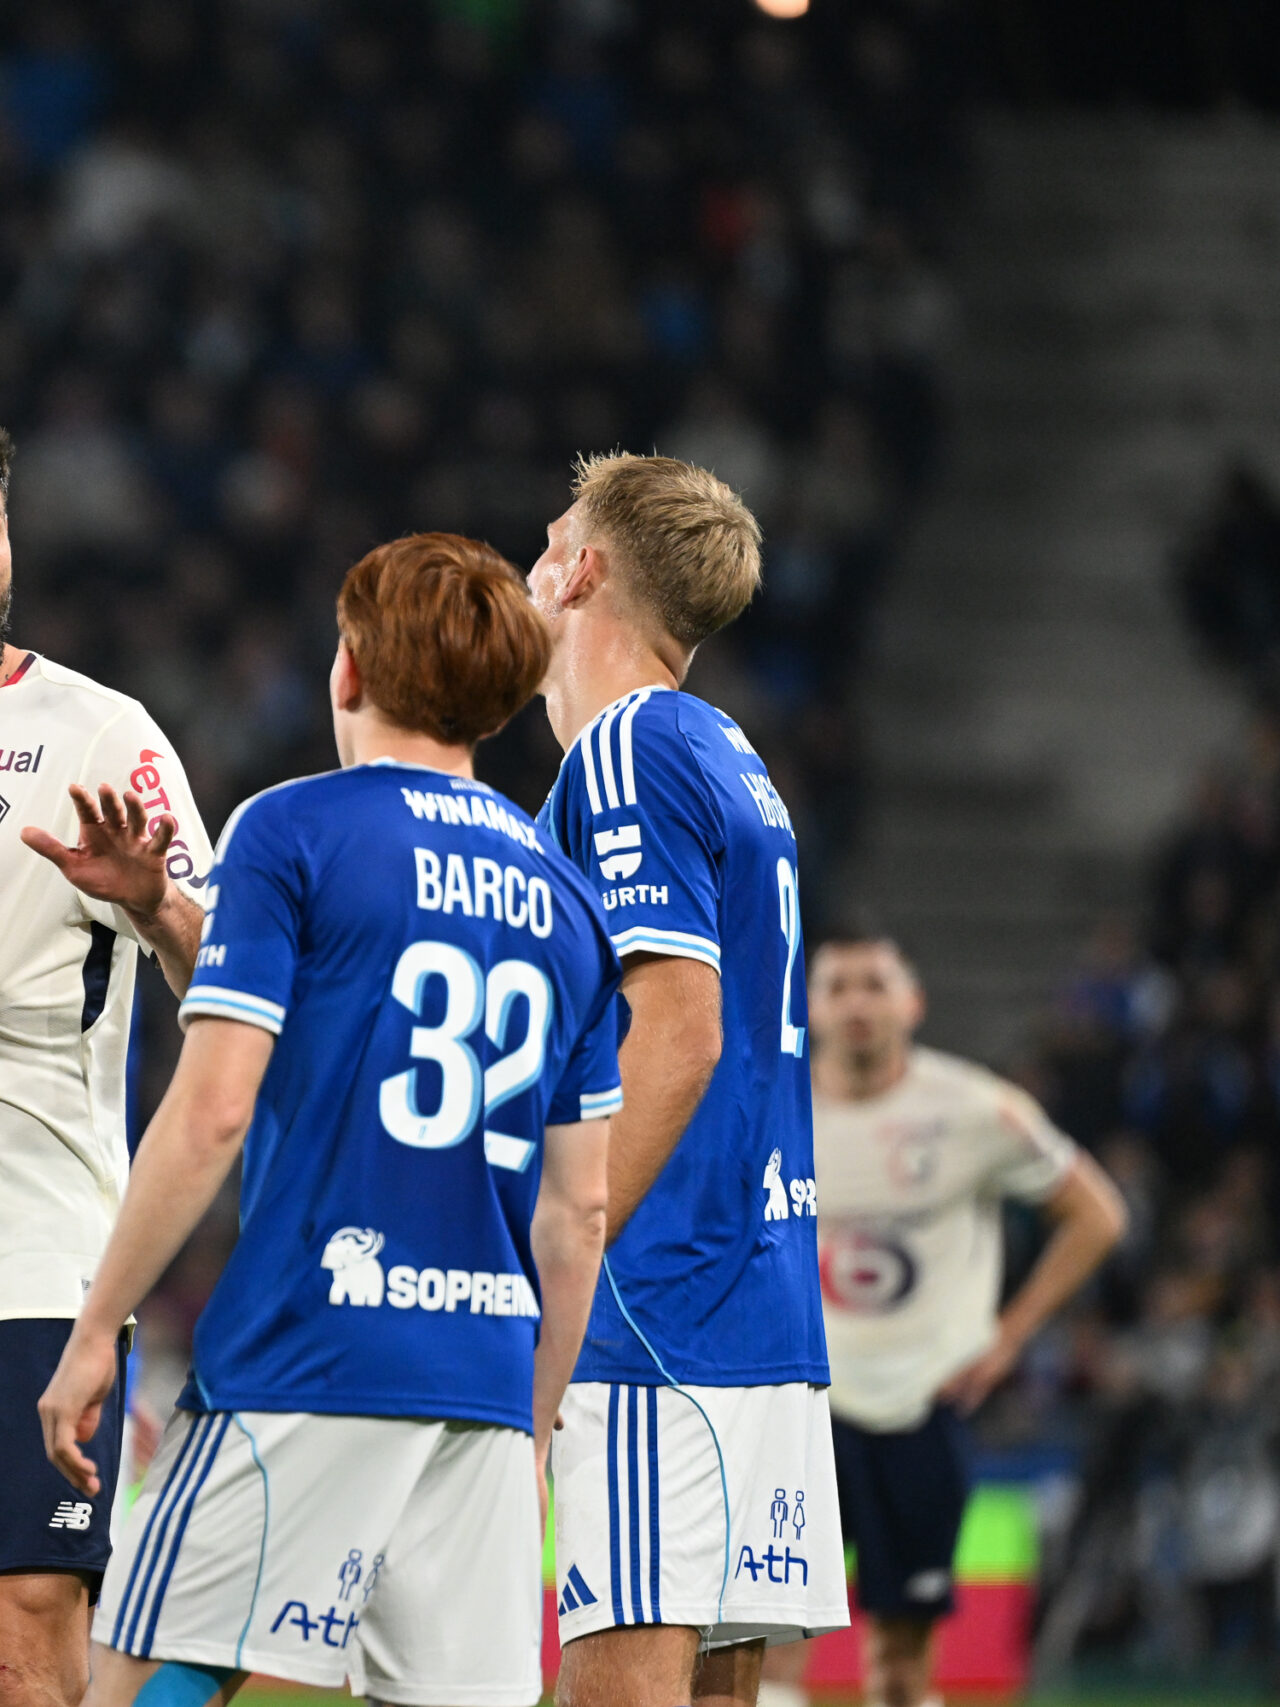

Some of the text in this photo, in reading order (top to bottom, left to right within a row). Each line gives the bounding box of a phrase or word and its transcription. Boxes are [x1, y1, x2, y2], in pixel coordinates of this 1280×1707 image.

[400, 787, 545, 856] WINAMAX
[414, 847, 553, 939] BARCO
[602, 885, 669, 911] ÜRTH
[378, 940, 554, 1174] 32
[734, 1544, 808, 1587] Ath
